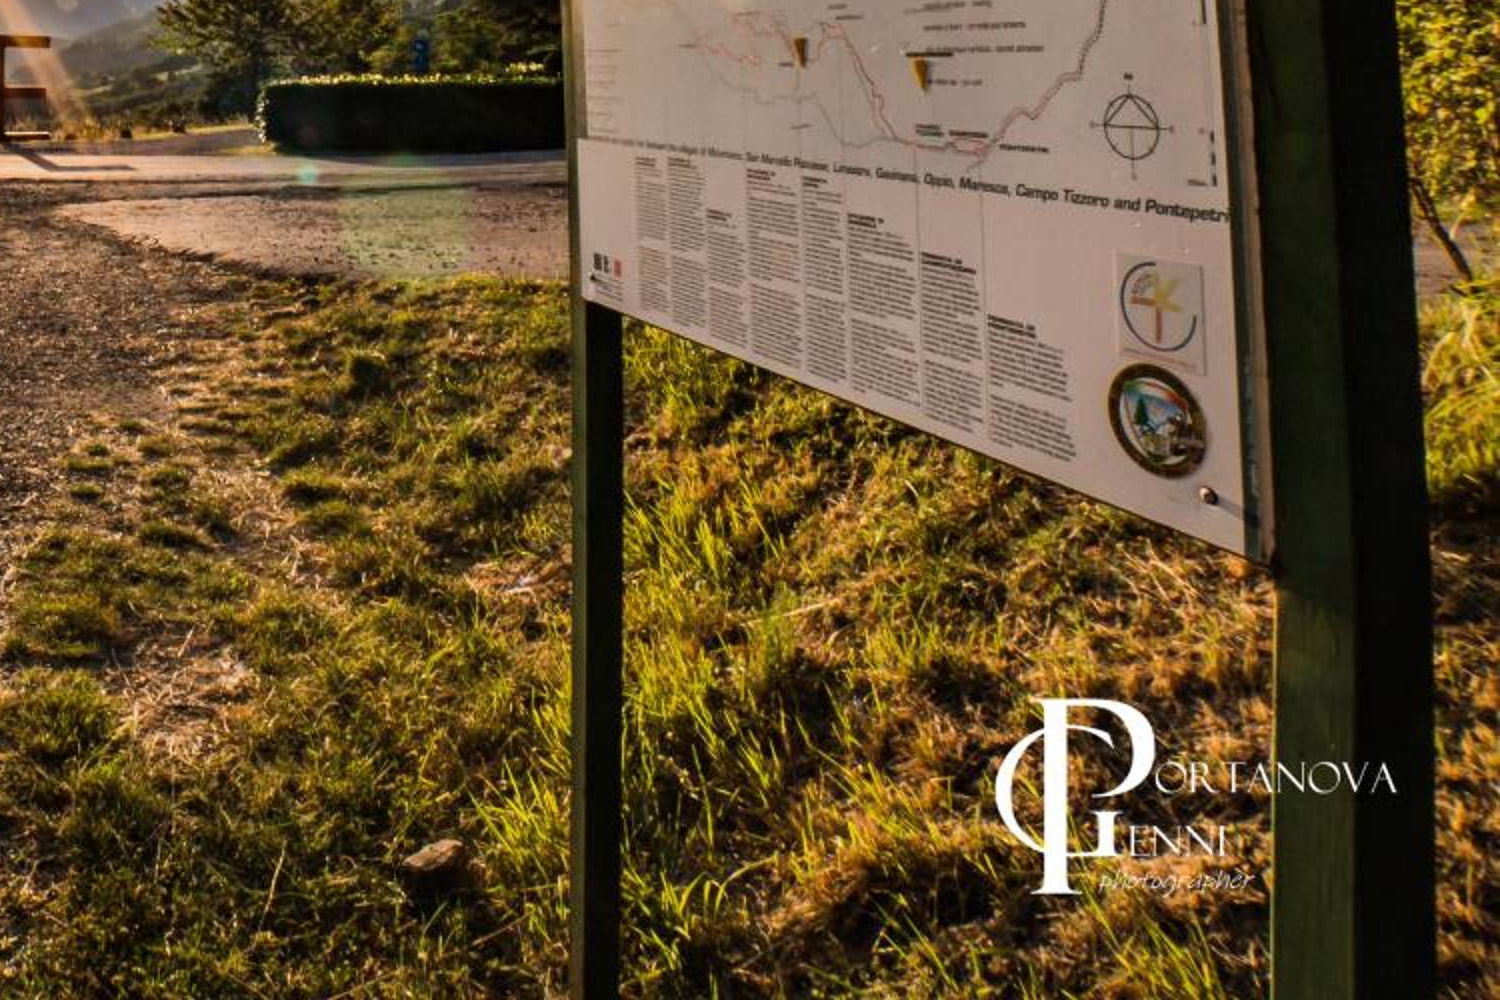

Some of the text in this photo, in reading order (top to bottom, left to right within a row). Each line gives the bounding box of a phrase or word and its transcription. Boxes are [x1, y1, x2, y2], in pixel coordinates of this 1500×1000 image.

[959, 176, 1011, 197] Maresca,
[1015, 183, 1059, 202] Campo
[1063, 189, 1109, 208] Tizzoro
[1113, 198, 1141, 212] and
